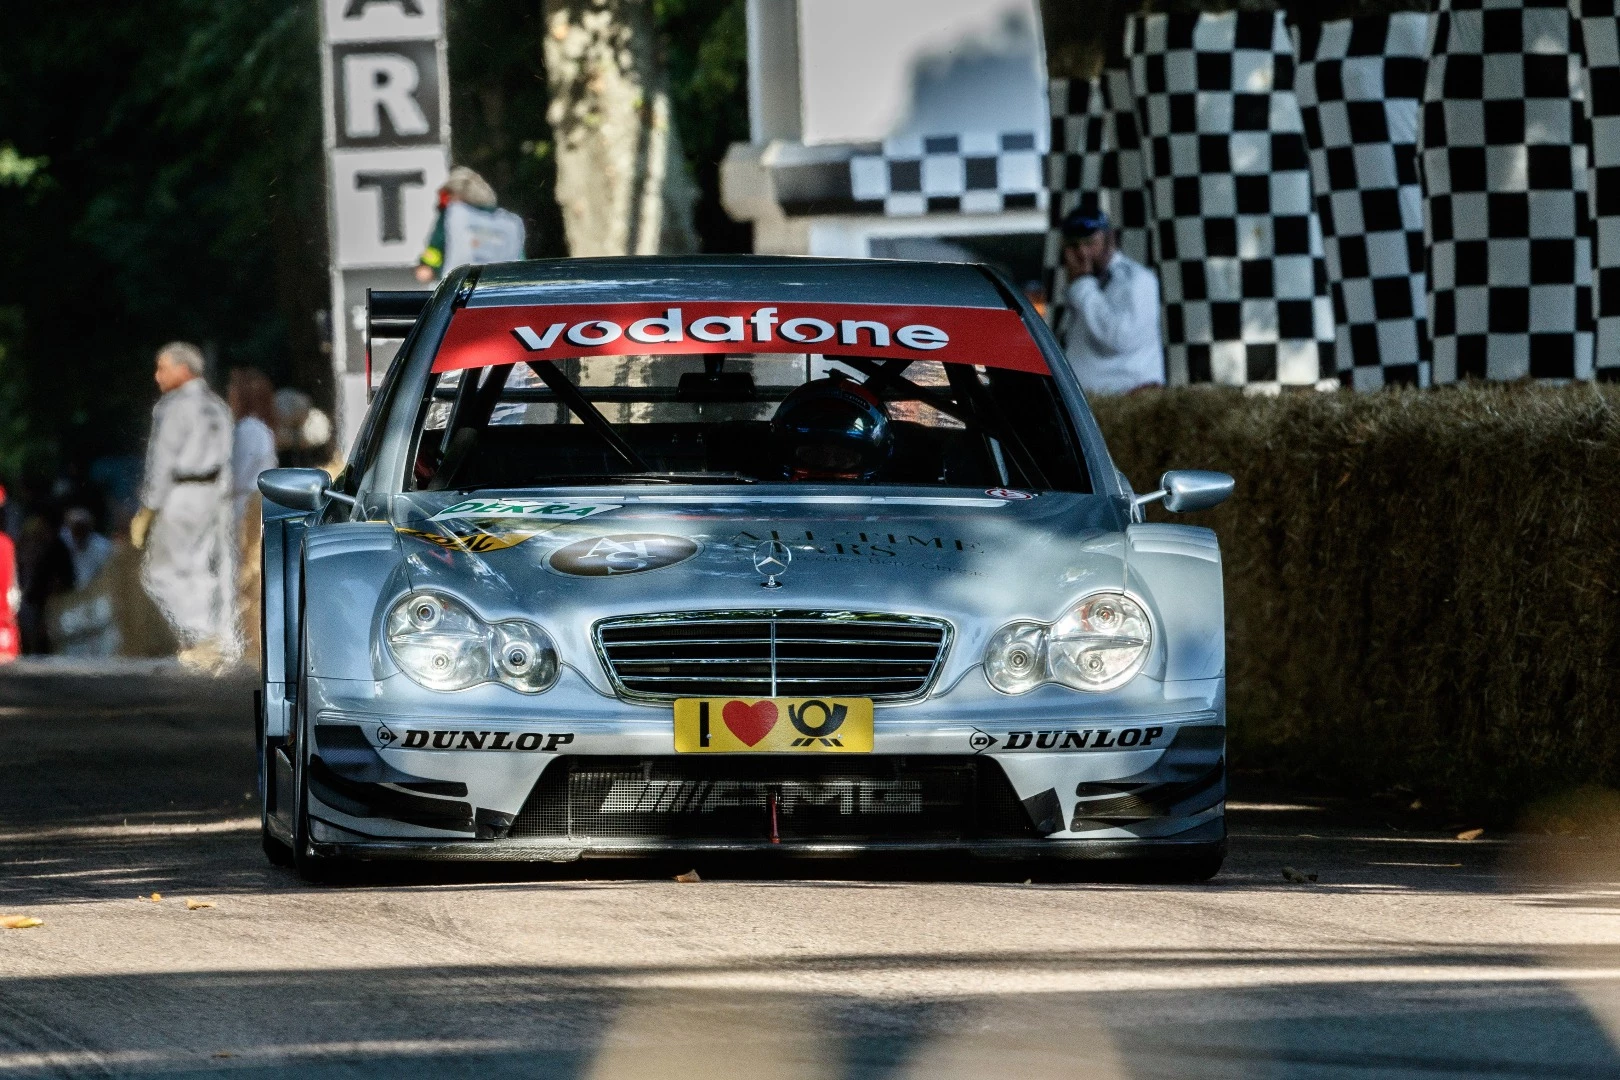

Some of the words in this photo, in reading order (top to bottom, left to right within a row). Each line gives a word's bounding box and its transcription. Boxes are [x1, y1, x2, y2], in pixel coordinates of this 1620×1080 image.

[343, 0, 429, 243] RT
[514, 307, 950, 351] vodafone
[439, 501, 598, 518] DEKRA
[402, 729, 574, 751] DUNLOP
[1002, 727, 1163, 750] DUNLOP
